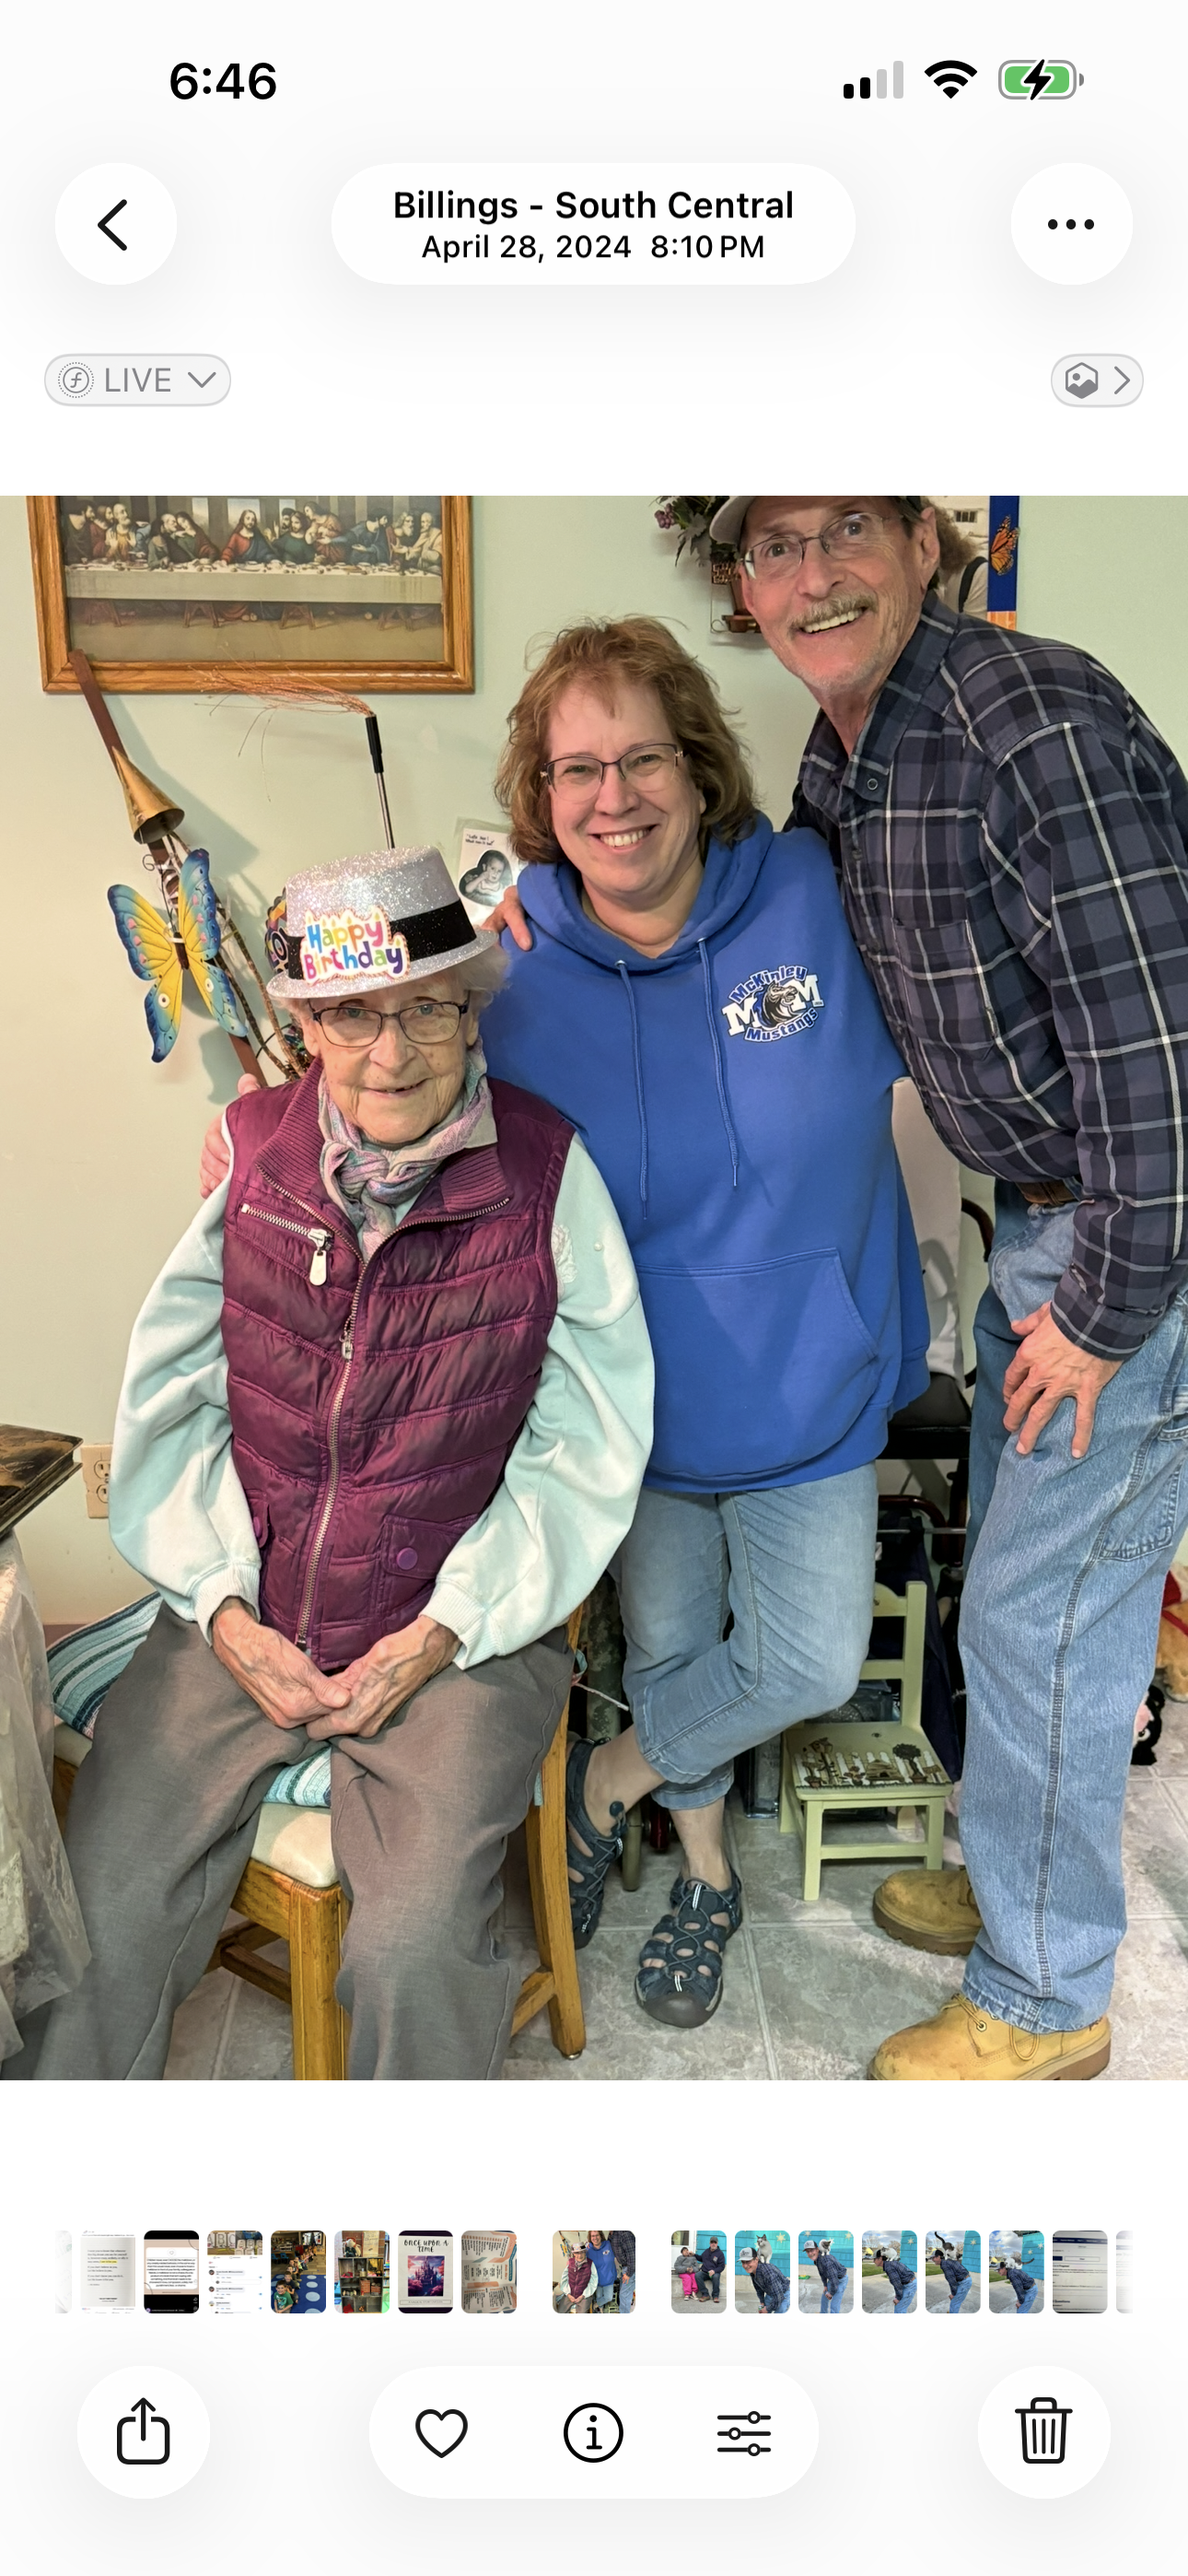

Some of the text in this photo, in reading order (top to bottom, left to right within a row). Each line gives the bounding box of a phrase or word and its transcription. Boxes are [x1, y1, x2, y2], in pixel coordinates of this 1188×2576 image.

[169, 62, 277, 100] 6:46
[394, 189, 518, 226] Billings
[555, 190, 656, 219] South
[668, 190, 793, 219] Central
[421, 233, 763, 263] April 28, 2024 8:10 PM
[105, 368, 171, 392] LIVE
[307, 921, 385, 953] Happy
[303, 941, 403, 979] Birthday
[728, 966, 808, 1003] McKinley
[745, 1008, 818, 1041] Mustangs
